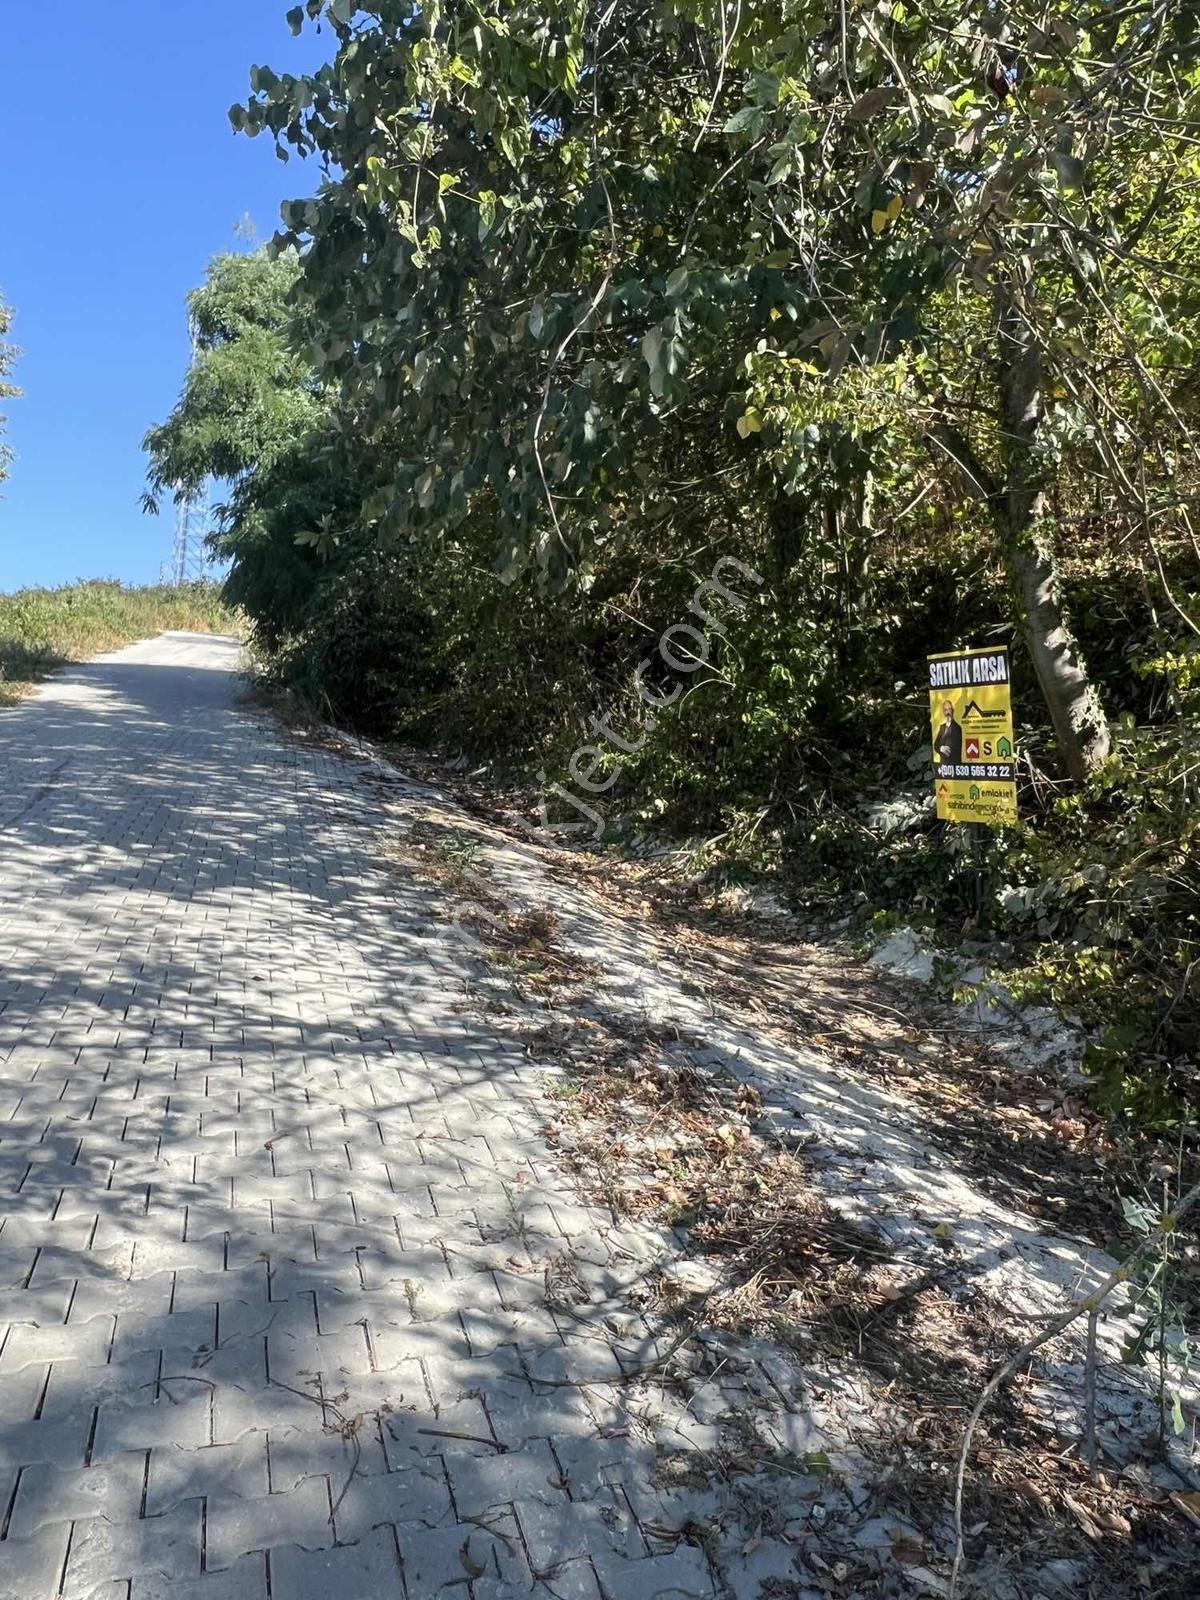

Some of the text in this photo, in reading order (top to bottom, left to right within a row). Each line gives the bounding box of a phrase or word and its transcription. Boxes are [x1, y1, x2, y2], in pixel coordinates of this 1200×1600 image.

[929, 655, 1007, 687] SATILIK ARSA
[983, 741, 992, 756] S
[986, 765, 998, 777] 32
[999, 765, 1011, 777] 22
[947, 800, 1003, 812] sahibindcom
